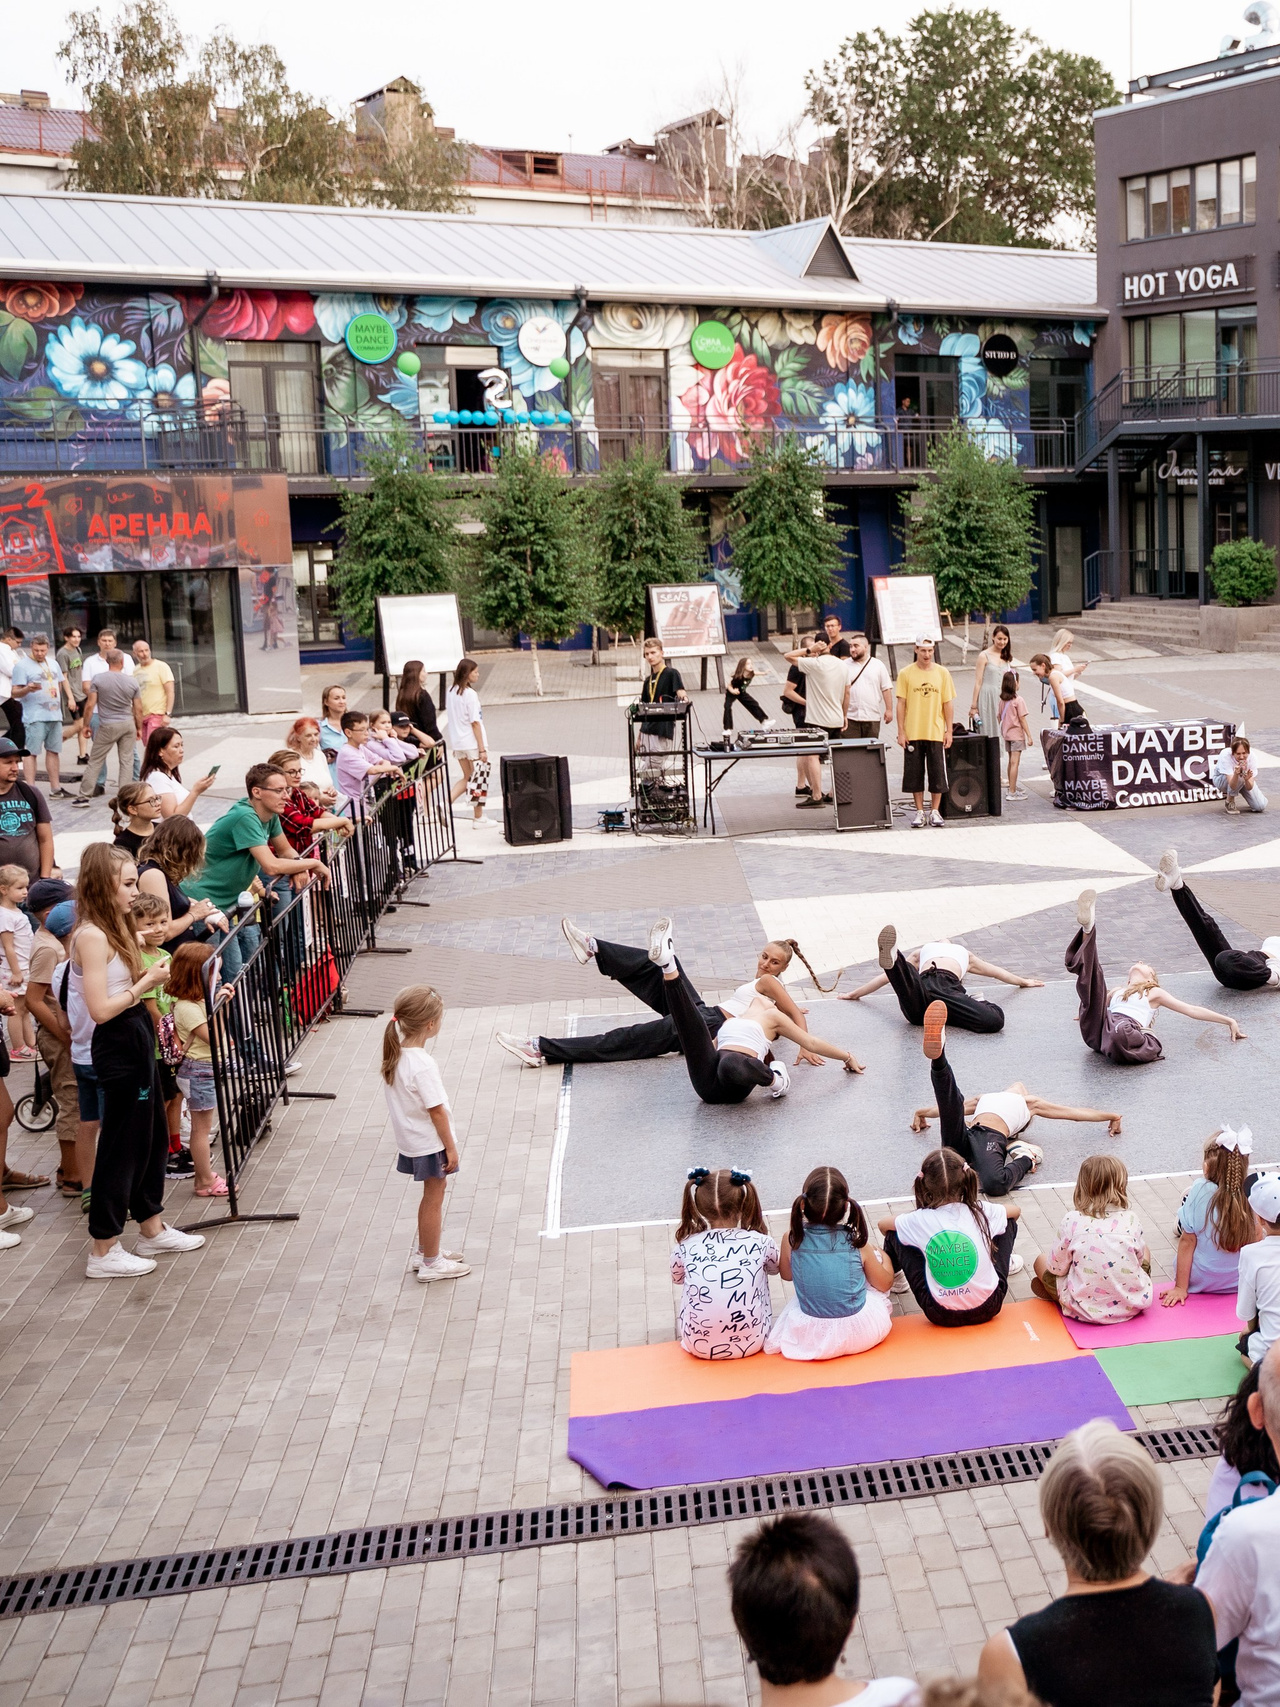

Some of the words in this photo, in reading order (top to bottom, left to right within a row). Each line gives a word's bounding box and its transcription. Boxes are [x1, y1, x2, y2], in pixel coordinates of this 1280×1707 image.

[1124, 272, 1168, 300] HOT
[1174, 263, 1239, 293] YOGA
[355, 324, 389, 334] MAYBE
[355, 335, 389, 345] DANCE
[1158, 450, 1243, 479] Jamna
[87, 512, 213, 540] АРЕНДА
[660, 591, 689, 602] SENS
[1111, 725, 1226, 755] MAYBE
[1063, 741, 1104, 753] DANCE
[1063, 752, 1104, 762] Community
[1064, 779, 1107, 791] MAYBE
[1065, 791, 1109, 801] DANCE
[929, 1242, 970, 1255] MAYBE
[931, 1255, 971, 1268] DANCE
[933, 1269, 971, 1278] COMMUNITY
[938, 1287, 971, 1297] SAMIRA
